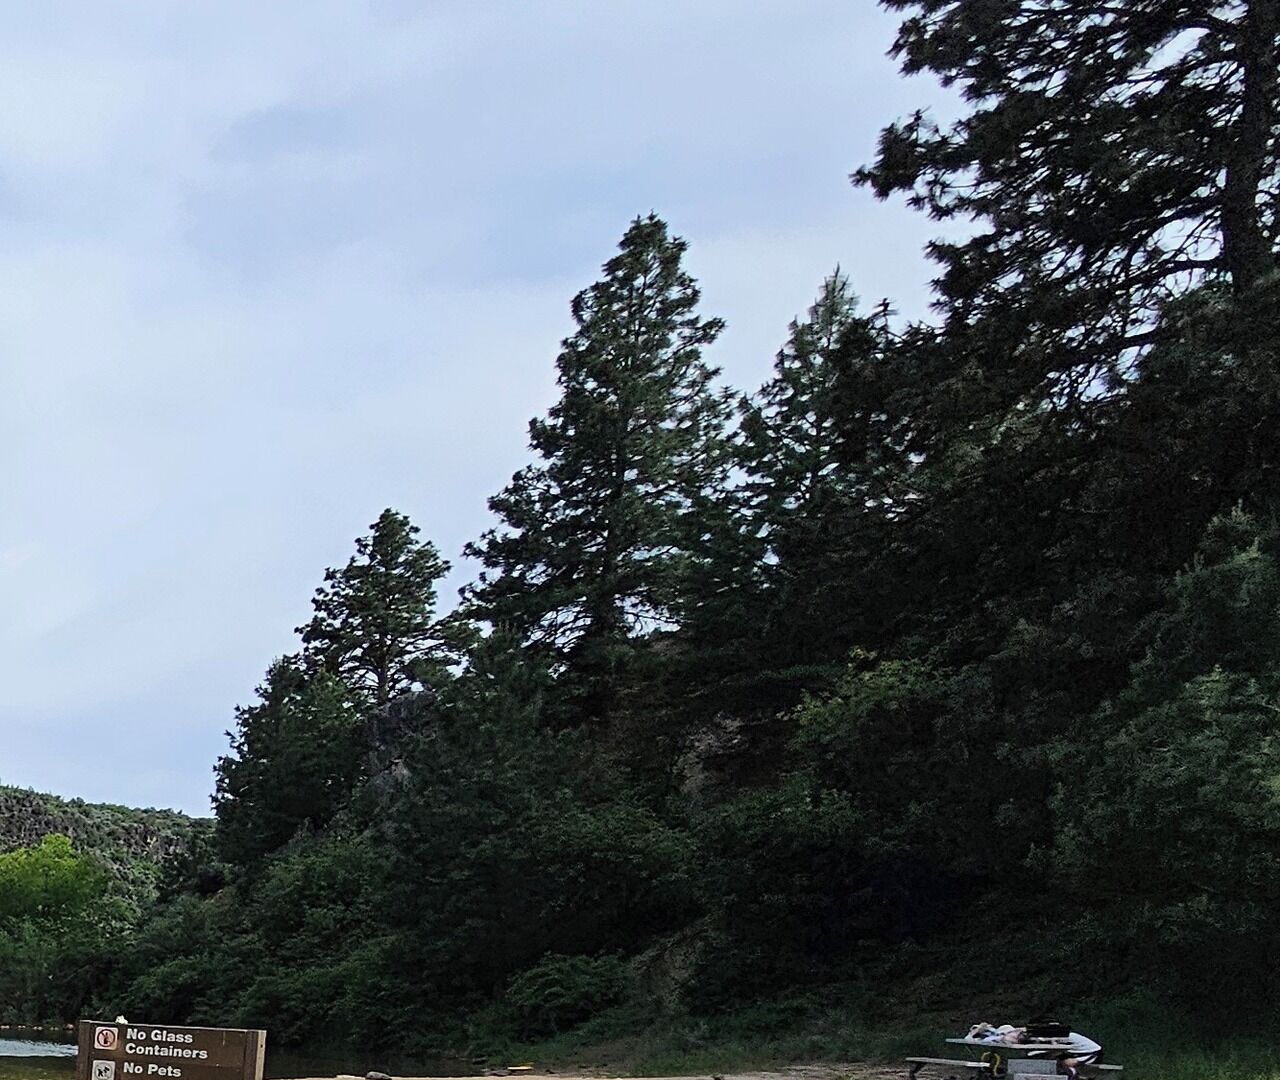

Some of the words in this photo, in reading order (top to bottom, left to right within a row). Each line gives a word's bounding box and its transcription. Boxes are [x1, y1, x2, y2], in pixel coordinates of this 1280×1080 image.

[126, 1028, 146, 1040] No
[151, 1029, 193, 1043] Glass
[125, 1043, 208, 1059] Containers
[123, 1062, 143, 1074] No
[148, 1064, 181, 1077] Pets
